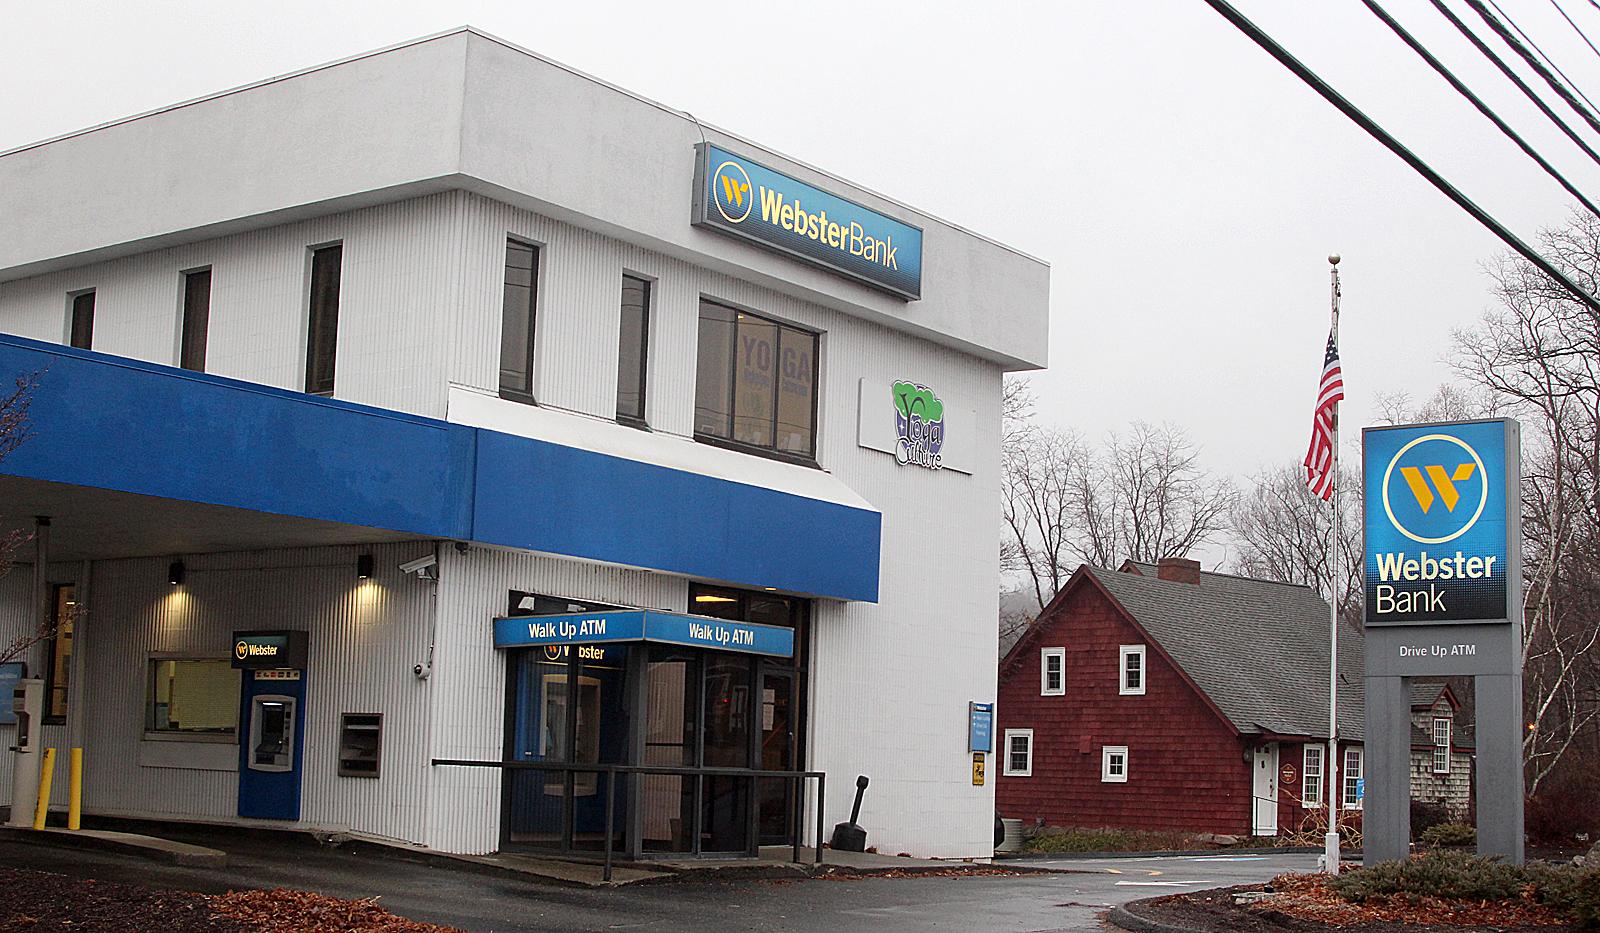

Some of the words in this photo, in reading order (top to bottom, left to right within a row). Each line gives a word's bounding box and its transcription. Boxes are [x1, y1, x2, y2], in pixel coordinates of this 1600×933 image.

[899, 393, 940, 453] Yoga
[897, 438, 942, 467] Culture
[1376, 551, 1496, 582] Webster
[1376, 583, 1447, 613] Bank
[528, 623, 556, 638] Walk
[559, 621, 577, 640] Up
[579, 619, 606, 636] ATM
[689, 622, 713, 641] Walk
[715, 626, 730, 646] Up
[731, 628, 754, 646] ATM
[249, 644, 277, 656] Webster
[1399, 645, 1427, 657] Drive
[1431, 645, 1448, 658] Up
[1450, 644, 1476, 656] ATM
